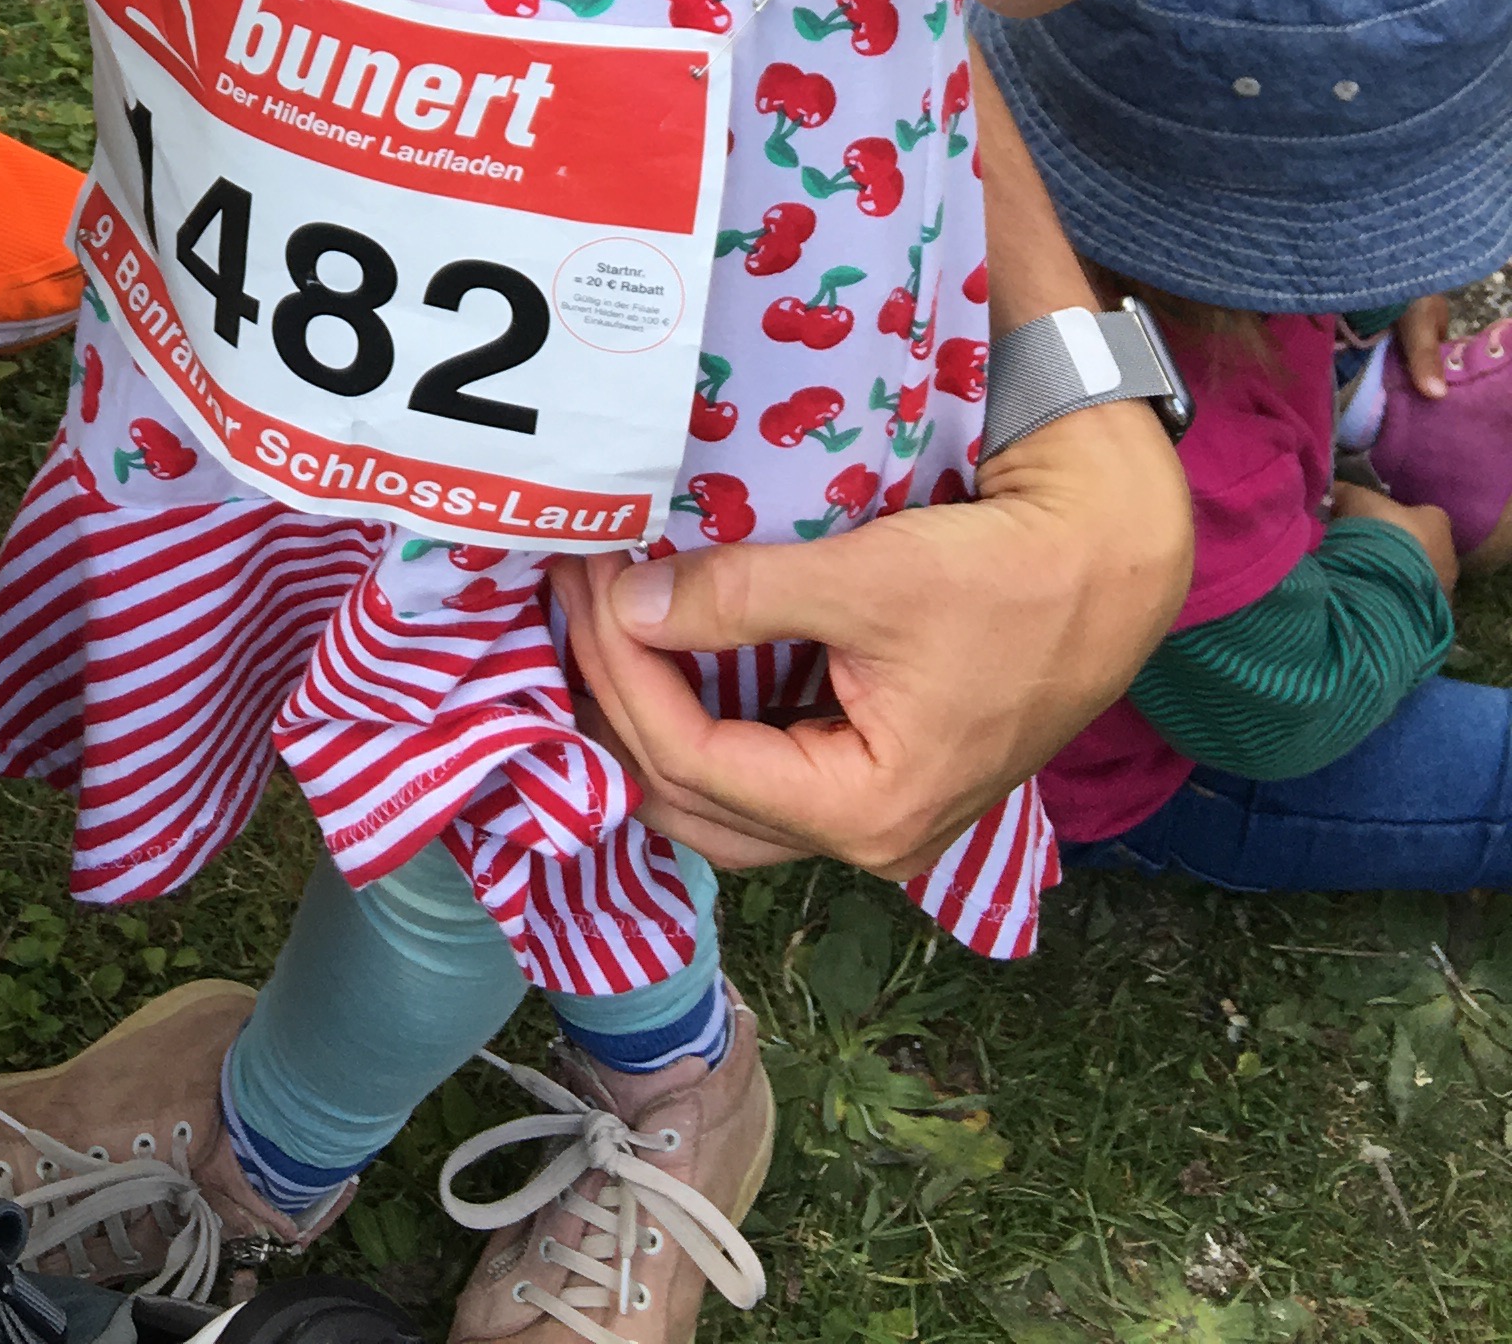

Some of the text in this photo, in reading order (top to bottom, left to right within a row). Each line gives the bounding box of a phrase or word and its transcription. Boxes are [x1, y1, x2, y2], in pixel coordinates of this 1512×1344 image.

[215, 72, 525, 183] Der Hildener Laufladen
[585, 275, 603, 287] 20
[606, 278, 617, 290] €
[620, 281, 665, 296] Rabatt
[596, 262, 646, 279] Startnr.
[90, 214, 114, 262] 9.
[255, 427, 636, 534] Schloss-Lauf
